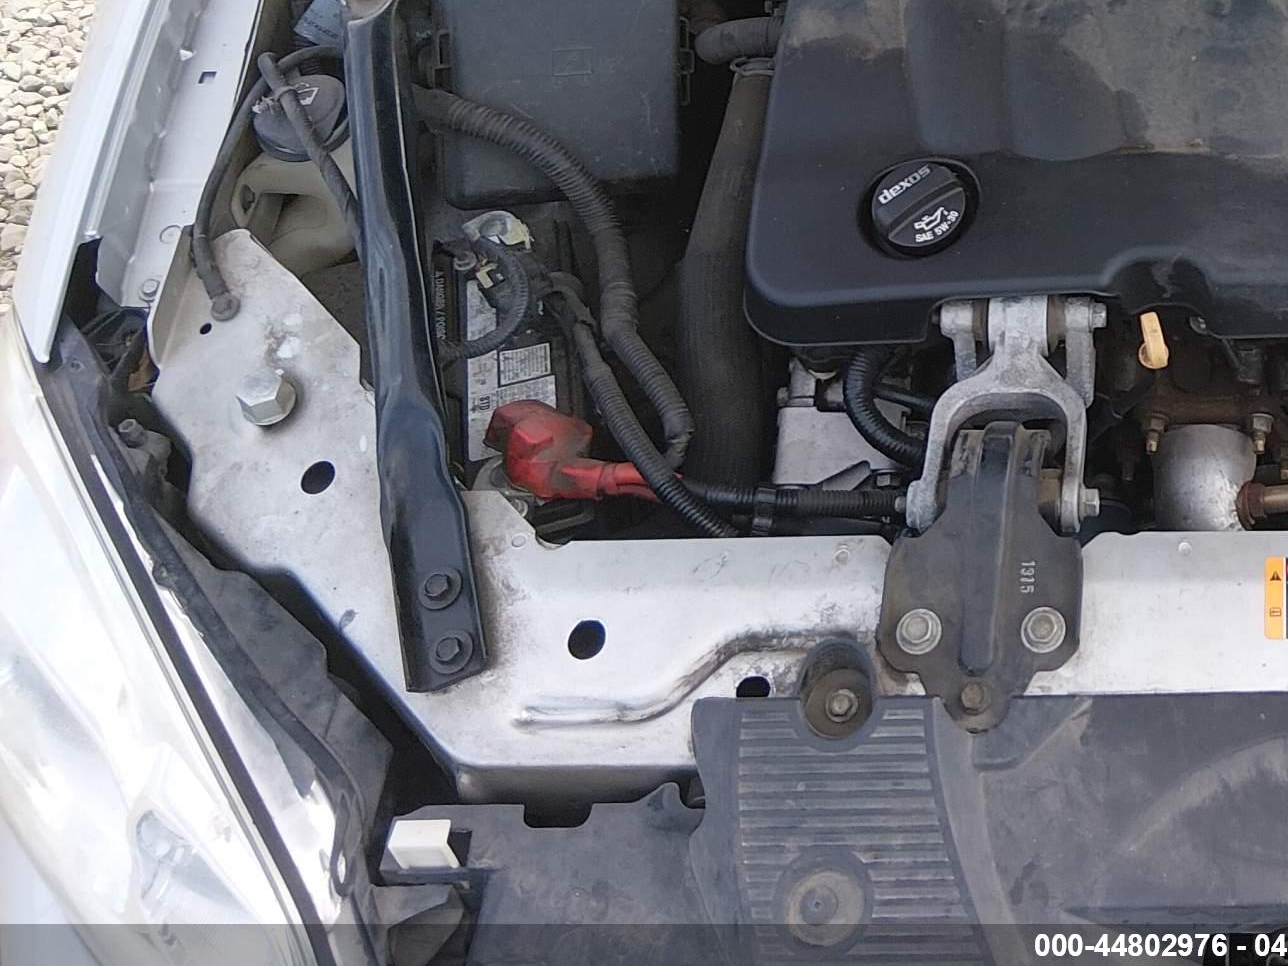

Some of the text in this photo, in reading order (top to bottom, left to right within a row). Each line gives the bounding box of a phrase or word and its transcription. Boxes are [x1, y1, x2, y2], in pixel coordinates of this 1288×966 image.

[878, 164, 931, 204] dexos
[914, 210, 959, 243] SAE 5W-30
